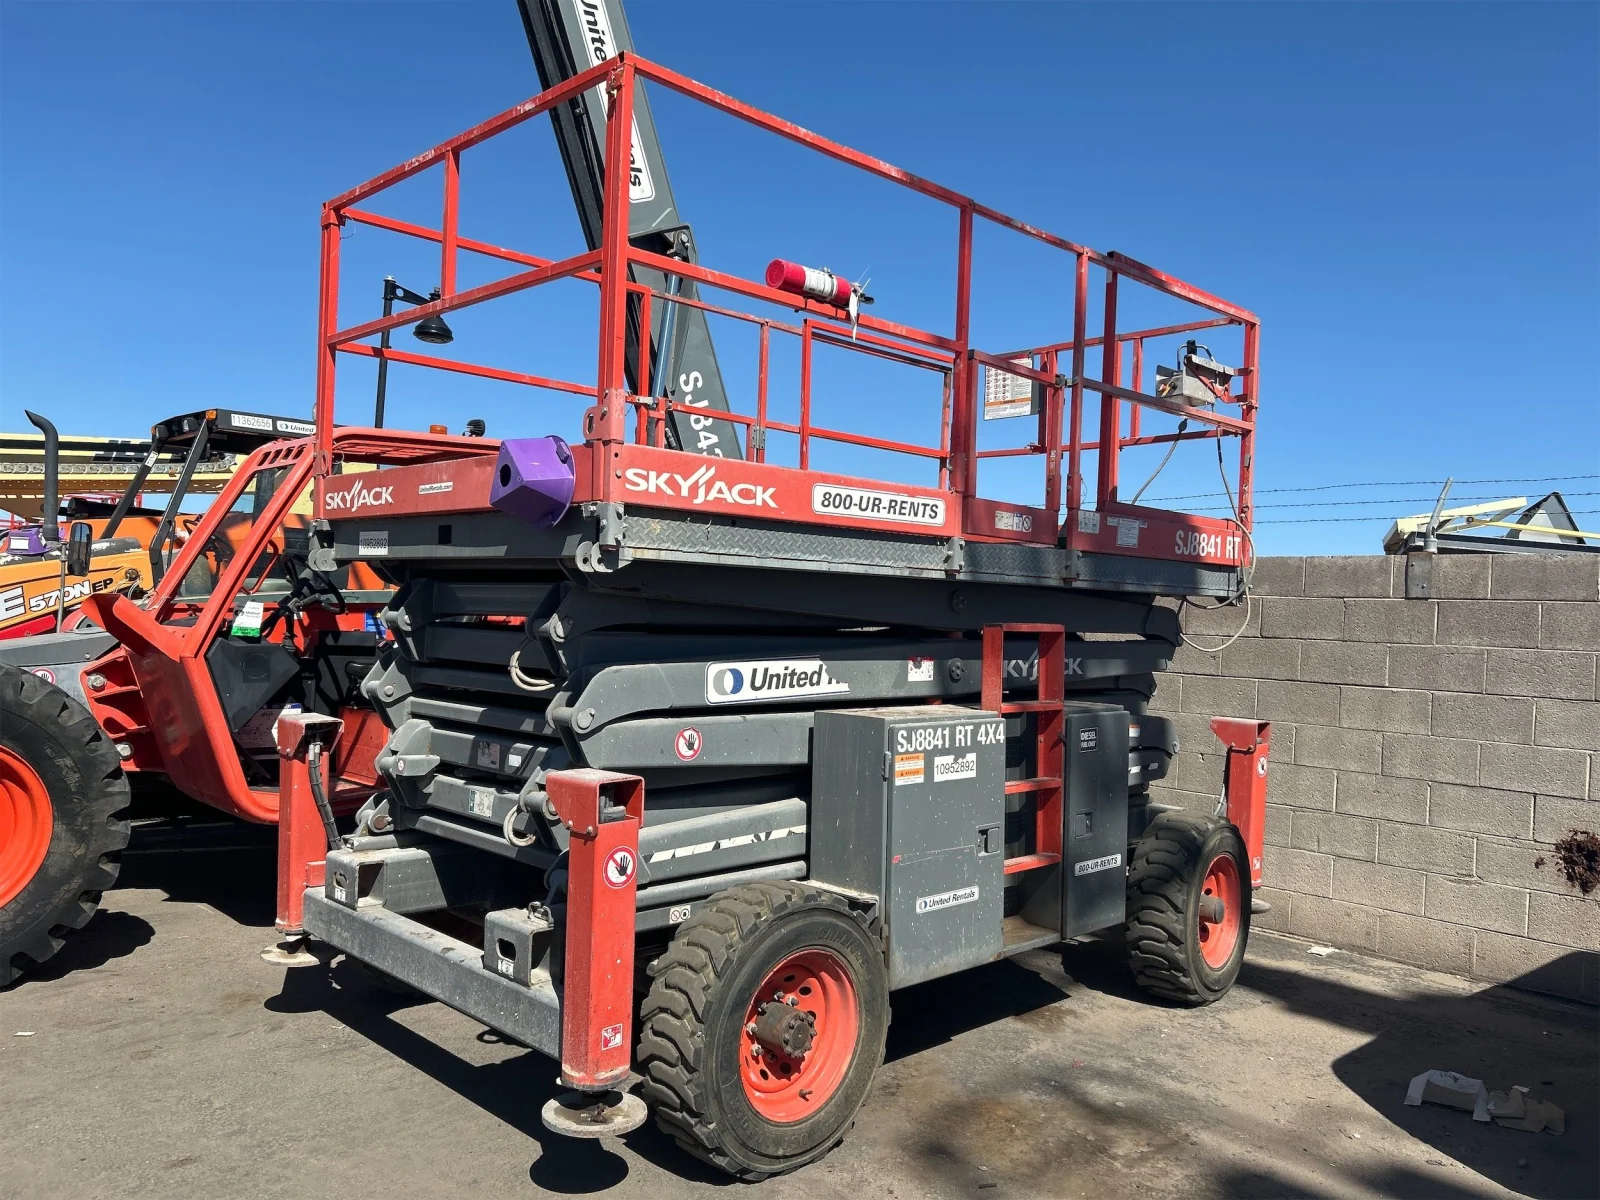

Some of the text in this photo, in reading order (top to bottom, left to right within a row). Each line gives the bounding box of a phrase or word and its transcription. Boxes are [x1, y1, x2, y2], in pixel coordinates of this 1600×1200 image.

[582, 0, 607, 62] nite
[232, 415, 271, 428] 11362656
[290, 424, 315, 433] United
[680, 371, 723, 458] SJ84
[325, 479, 394, 512] SKYJACK
[625, 464, 779, 508] SKYJACK
[821, 491, 939, 519] 800-UR-RENTS
[1175, 530, 1222, 558] SJ8841
[1225, 535, 1241, 560] RT
[92, 577, 114, 593] EP
[750, 664, 823, 692] United
[897, 722, 1005, 753] SJ8841 RT 4X4
[1081, 732, 1096, 740] DIESEL
[935, 760, 975, 775] 10952892
[1078, 856, 1118, 873] 800-UR-RENTS
[928, 890, 975, 908] United Rentals
